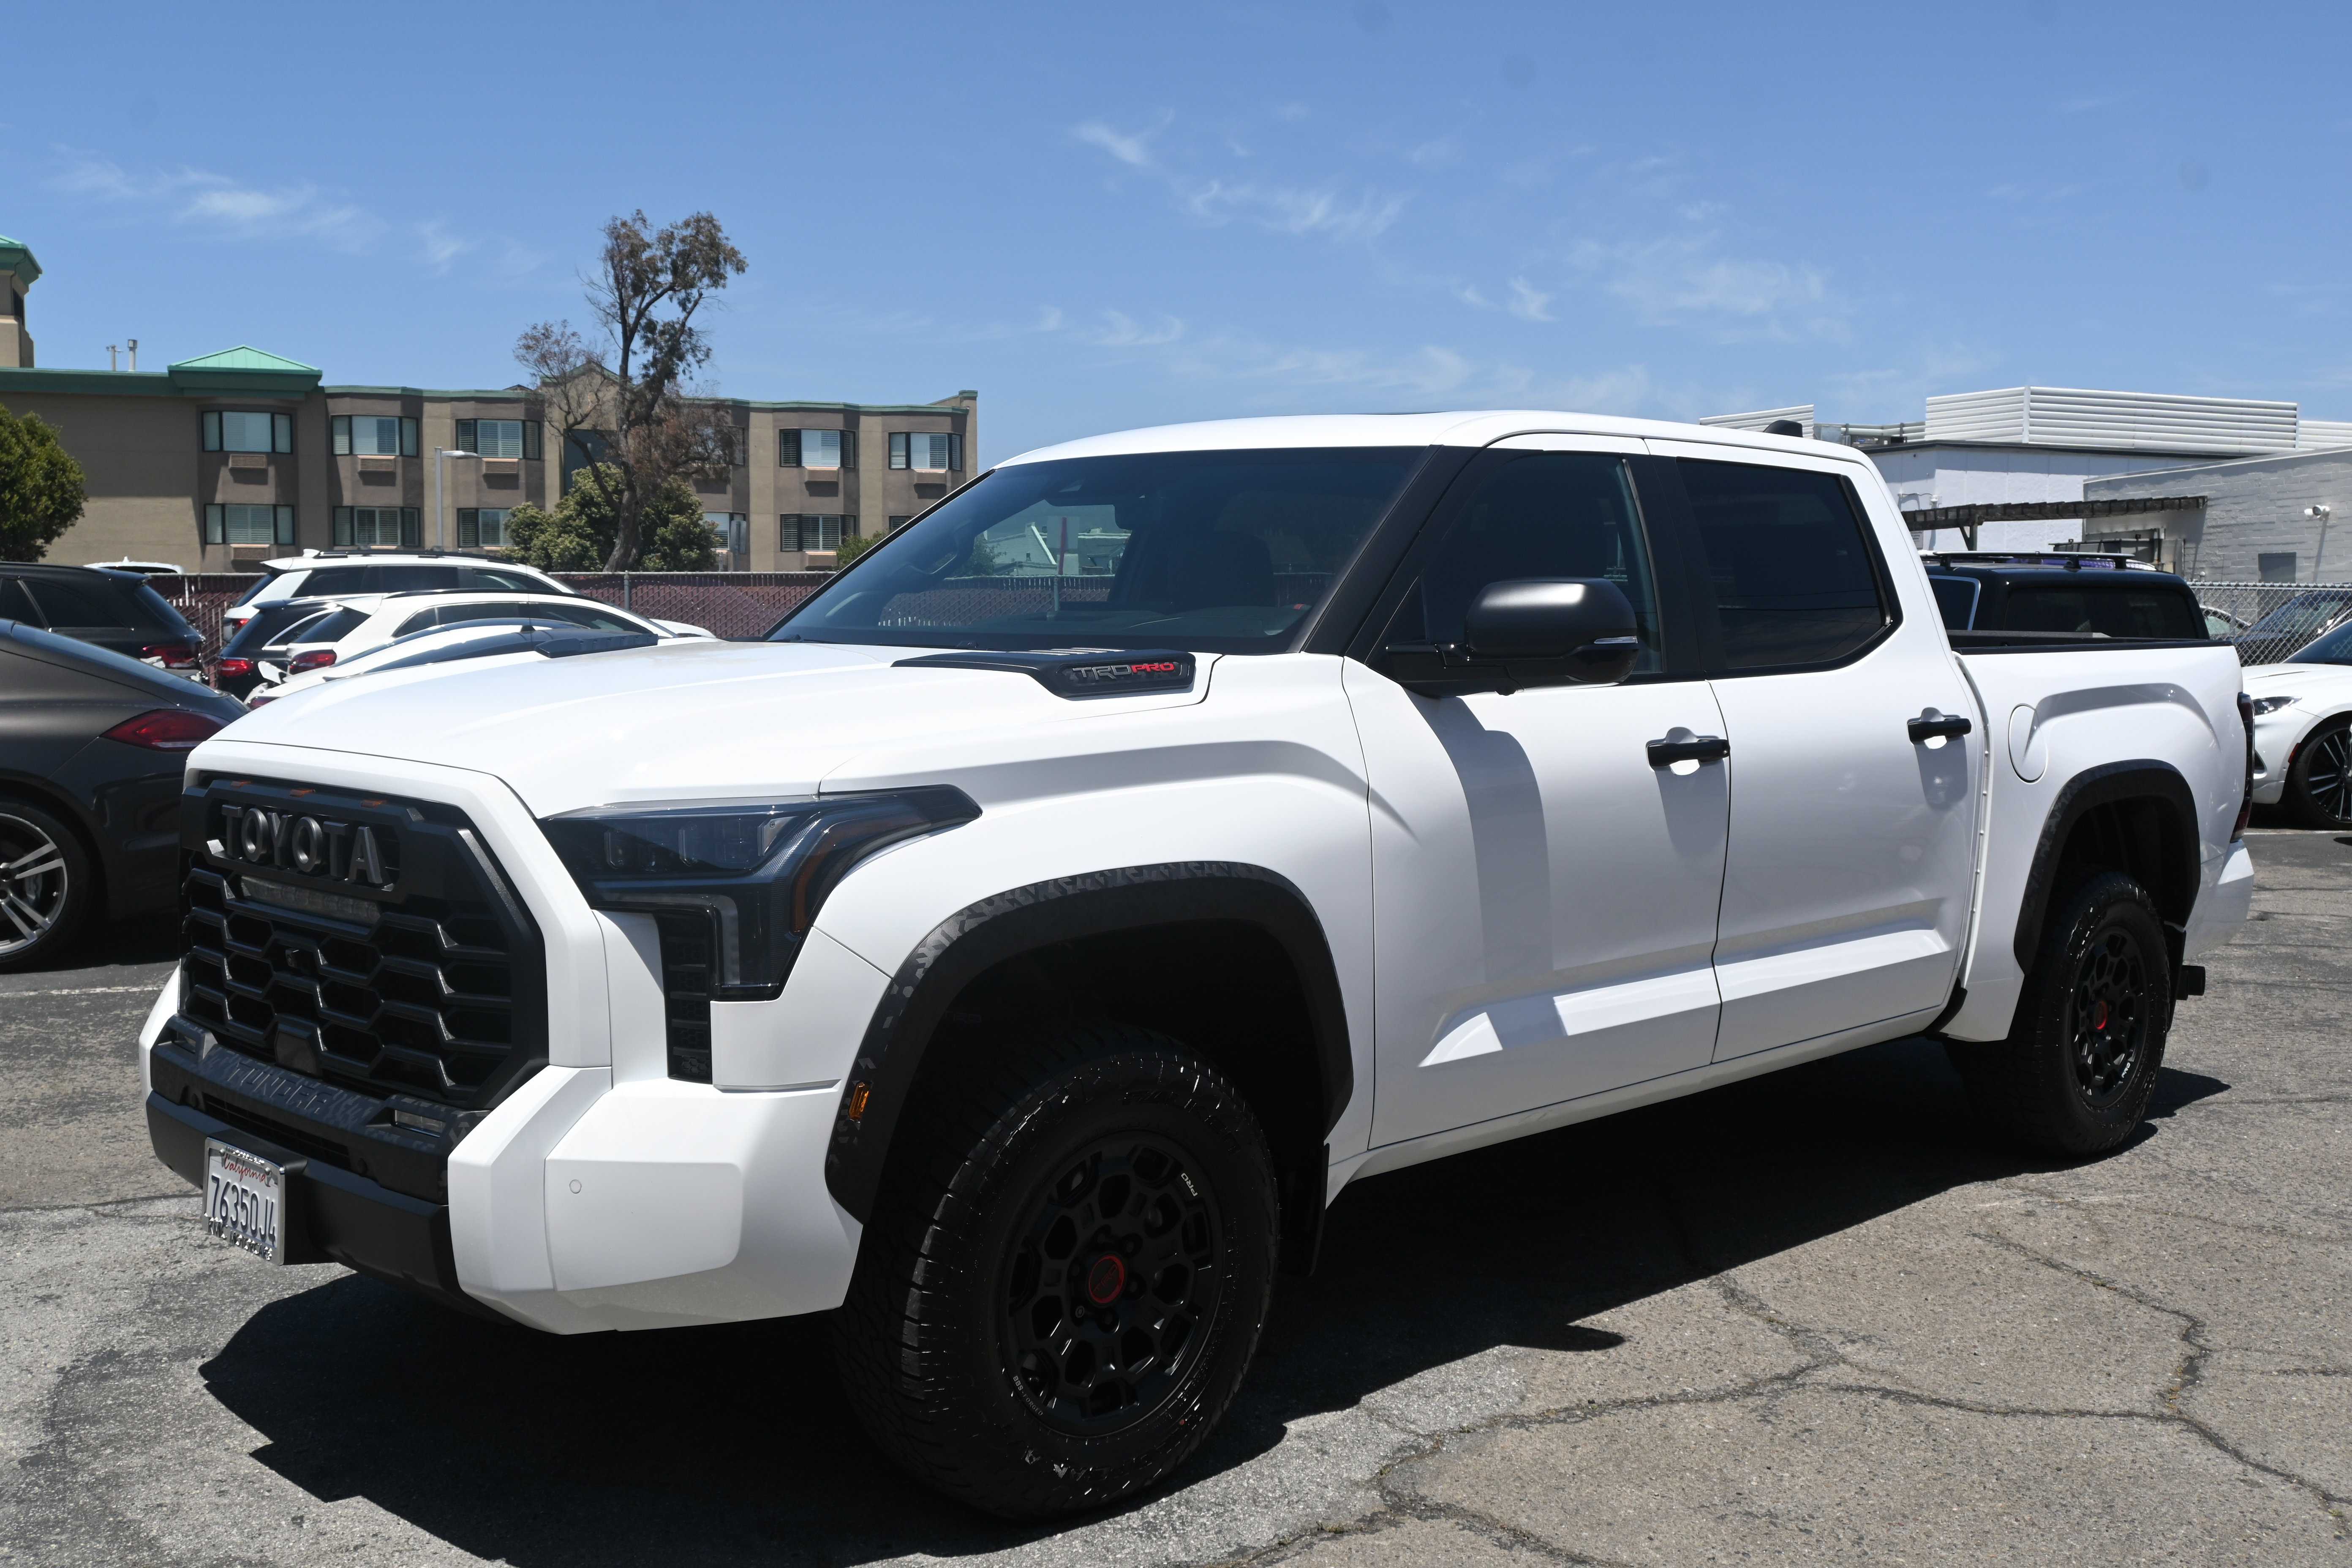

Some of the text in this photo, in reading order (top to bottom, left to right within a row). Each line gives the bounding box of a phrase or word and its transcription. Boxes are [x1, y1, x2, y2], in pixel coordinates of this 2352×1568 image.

[1073, 663, 1175, 681] TRD PRO
[222, 804, 383, 884] TOYOTA
[227, 1062, 333, 1114] TUNDRA
[224, 1153, 271, 1187] California
[1181, 1173, 1198, 1197] PRO
[211, 1175, 275, 1241] 76350J4
[1093, 1263, 1117, 1292] TRD
